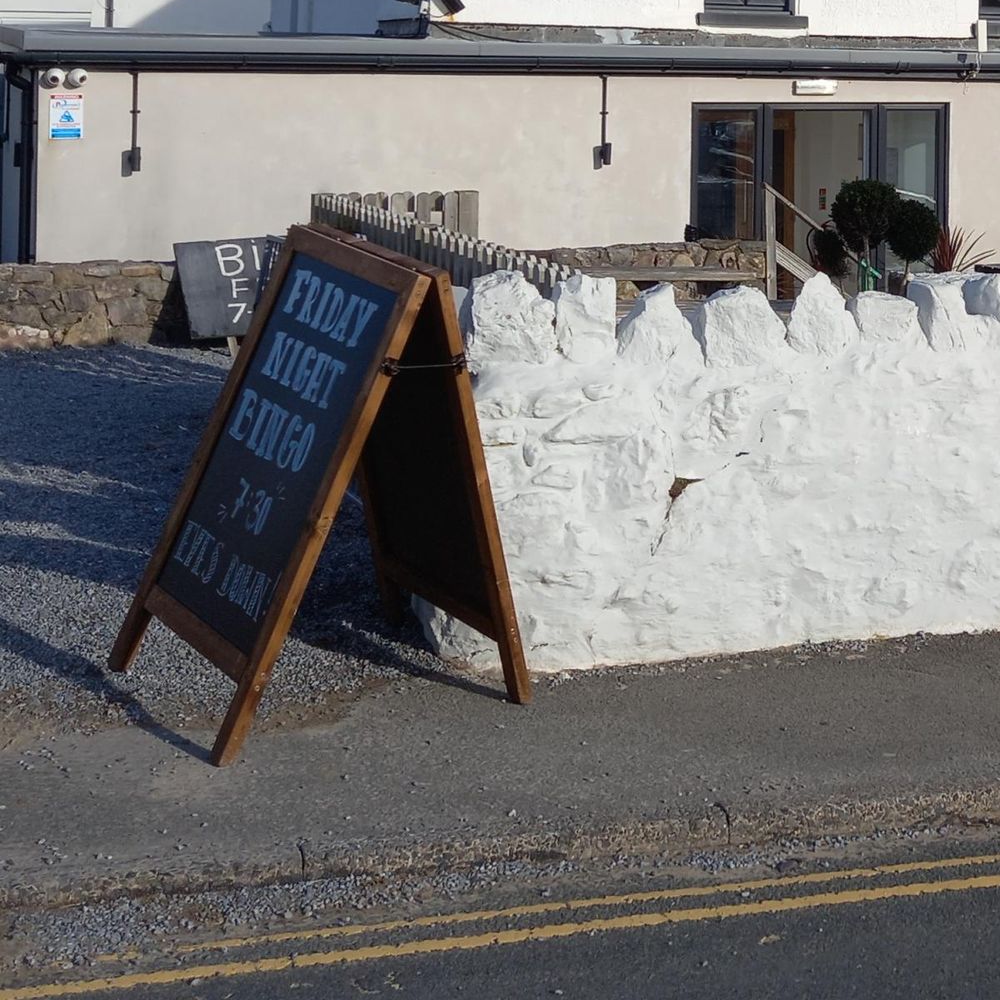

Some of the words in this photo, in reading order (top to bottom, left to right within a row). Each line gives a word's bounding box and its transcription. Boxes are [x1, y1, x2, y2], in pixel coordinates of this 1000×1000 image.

[215, 240, 261, 277] Bi
[283, 269, 380, 347] FRIDAY
[261, 331, 347, 410] NIGHT
[228, 388, 316, 473] BINGO
